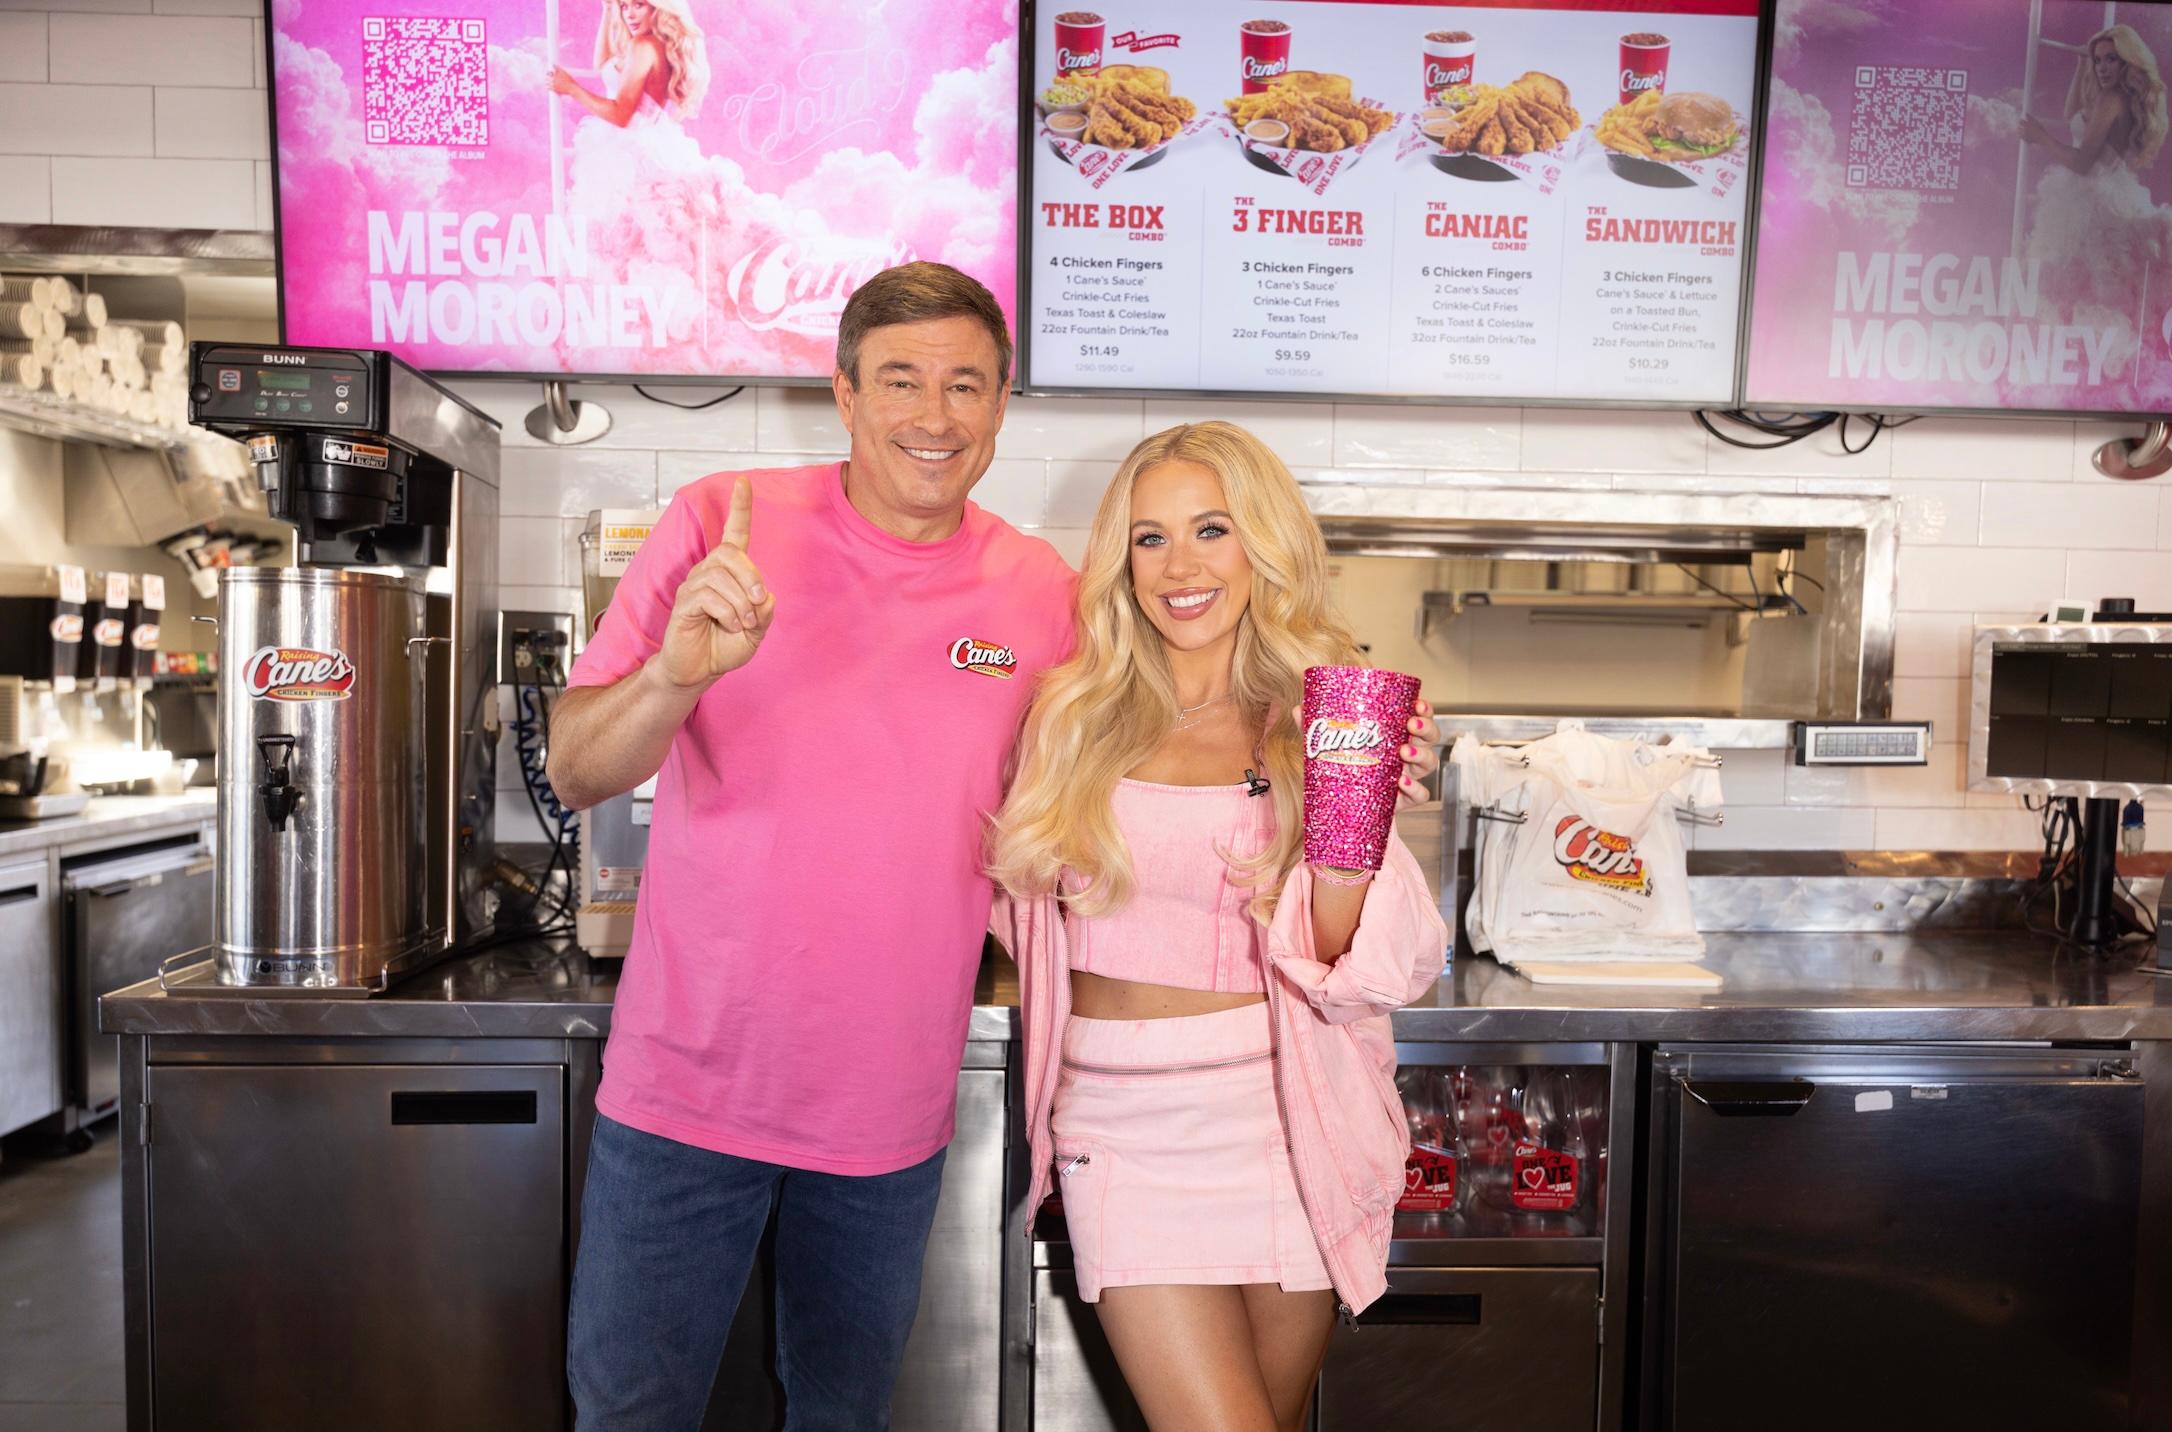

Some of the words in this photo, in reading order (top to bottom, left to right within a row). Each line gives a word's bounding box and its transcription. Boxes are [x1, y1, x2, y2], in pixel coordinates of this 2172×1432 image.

[1115, 34, 1133, 44] OUR
[1140, 37, 1176, 48] FAVORITE
[1057, 49, 1101, 71] Cane's
[1242, 56, 1288, 79] Cane's
[1424, 63, 1471, 88] Cane's
[1620, 69, 1666, 94] Cane's
[1092, 171, 1110, 189] ONE
[1108, 152, 1129, 172] LOVE
[1314, 176, 1330, 196] ONE
[1326, 154, 1344, 176] LOVE
[1234, 197, 1255, 206] THE
[1427, 202, 1448, 211] THE
[1041, 202, 1099, 228] THE
[1108, 205, 1164, 229] BOX
[1588, 206, 1607, 215] THE
[1232, 209, 1248, 232] 3
[1257, 209, 1364, 235] FINGER
[1425, 214, 1528, 239] CANIAC
[1128, 232, 1164, 241] COMBO
[1586, 218, 1737, 245] SANDWICH
[367, 210, 587, 278] MEGAN
[1328, 238, 1363, 247] COMBO
[1492, 242, 1527, 251] COMBO
[1700, 248, 1734, 256] COMBO
[1049, 257, 1058, 268] 4
[1062, 257, 1112, 269] Chicken
[1117, 258, 1163, 272] Fingers
[1242, 262, 1250, 272] 3
[1254, 262, 1304, 273] Chicken
[1307, 264, 1354, 277] Fingers
[1422, 267, 1430, 277] 6
[1433, 267, 1483, 278] Chicken
[1487, 268, 1533, 281] Fingers
[1603, 271, 1611, 282] 3
[1614, 271, 1664, 282] Chicken
[1667, 273, 1713, 286] Fingers
[1066, 276, 1070, 284] 1
[1073, 276, 1109, 285] Cane's
[1258, 280, 1262, 288] 1
[1265, 280, 1300, 290] Cane's
[1833, 252, 2040, 318] MEGAN
[1434, 284, 1442, 293] 2
[1444, 284, 1479, 294] Cane's
[1596, 288, 1631, 298] Cane's
[1668, 291, 1677, 300] &
[1680, 291, 1717, 301] Lettuce
[1062, 291, 1122, 302] Crinkle-Cut
[1124, 293, 1149, 302] Fries
[1253, 296, 1312, 306] Crinkle-Cut
[1314, 298, 1340, 307] Fries
[1432, 301, 1490, 311] Crinkle-Cut
[1493, 302, 1518, 312] Fries
[1610, 307, 1624, 315] on
[1626, 307, 1632, 315] a
[1636, 306, 1675, 316] Toasted
[369, 281, 677, 348] MORONEY
[1046, 308, 1074, 318] Texas
[1078, 308, 1105, 318] Toast
[1108, 309, 1115, 318] &
[1118, 309, 1166, 319] Coleslaw
[1266, 313, 1295, 323] Texas
[1299, 313, 1326, 324] Toast
[1416, 316, 1444, 327] Texas
[1447, 317, 1474, 327] Toast
[1477, 318, 1484, 327] &
[1488, 318, 1535, 328] Coleslaw
[1612, 321, 1670, 331] Crinkle-Cut
[1672, 323, 1696, 332] Fries
[1042, 324, 1067, 334] 22oz
[1070, 325, 1116, 335] Fountain
[1119, 325, 1169, 337] Drink/Tea
[1232, 329, 1258, 338] 22oz
[1261, 329, 1307, 340] Fountain
[1310, 330, 1359, 341] Drink/Tea
[1411, 333, 1436, 343] 32oz
[1440, 333, 1485, 344] Fountain
[1488, 334, 1536, 345] Drink/Tea
[1592, 337, 1617, 347] 22oz
[1620, 338, 1664, 348] Fountain
[1667, 339, 1716, 350] Drink/Tea
[1080, 344, 1120, 357] $11.49
[1274, 348, 1311, 361] $9.59
[1828, 318, 2118, 386] MORONEY
[263, 355, 305, 365] BUNN
[1449, 353, 1490, 365] $16.59
[1628, 357, 1669, 369] $10.29
[356, 458, 383, 467] SLOWLY
[280, 651, 321, 661] Raising
[951, 637, 1017, 669] Cane's
[247, 646, 354, 697] Cane's
[1306, 718, 1385, 759] Cane's
[1432, 1182, 1449, 1193] JUG
[1555, 1182, 1571, 1192] JUG
